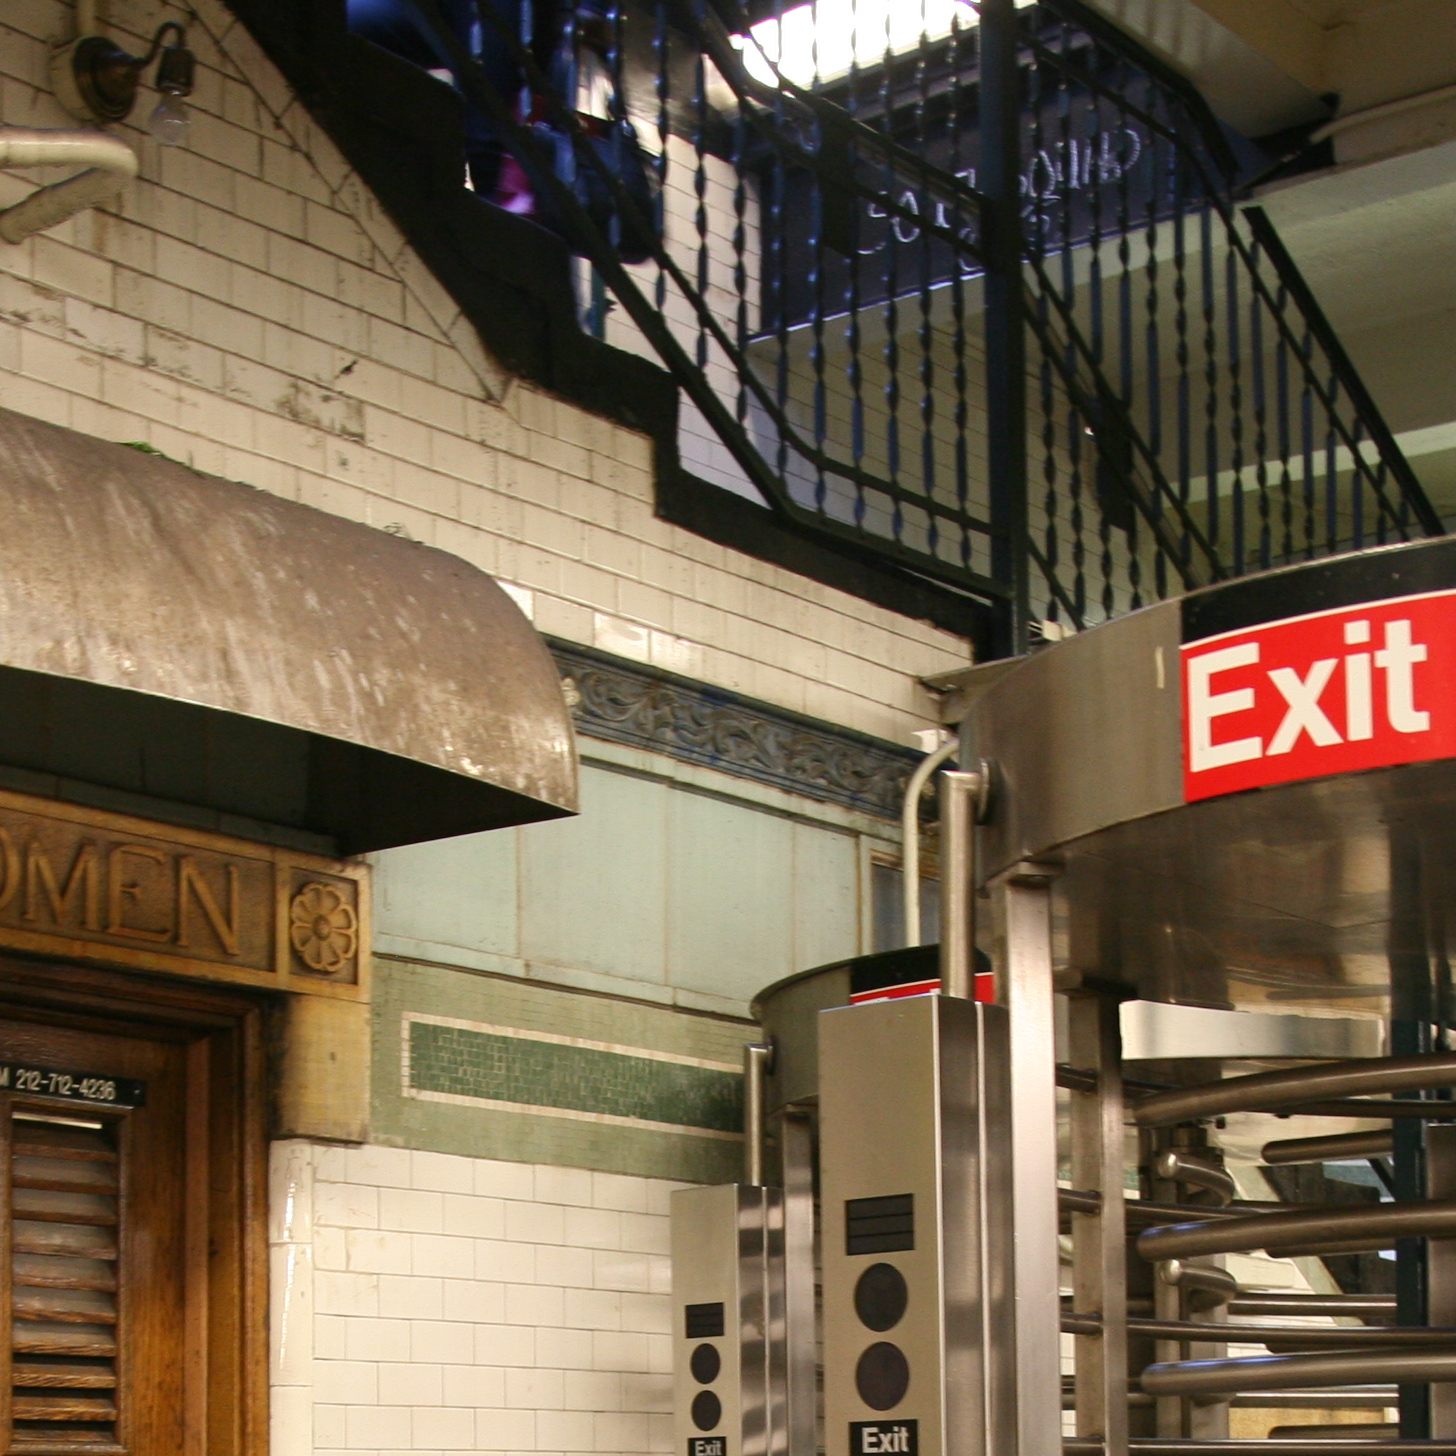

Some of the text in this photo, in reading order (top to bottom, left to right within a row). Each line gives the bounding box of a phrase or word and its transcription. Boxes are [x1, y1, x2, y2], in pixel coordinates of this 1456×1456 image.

[1188, 619, 1430, 773] Exit
[16, 1069, 116, 1101] 212-712-4236
[694, 1440, 722, 1456] Exit
[862, 1426, 909, 1454] Exit
